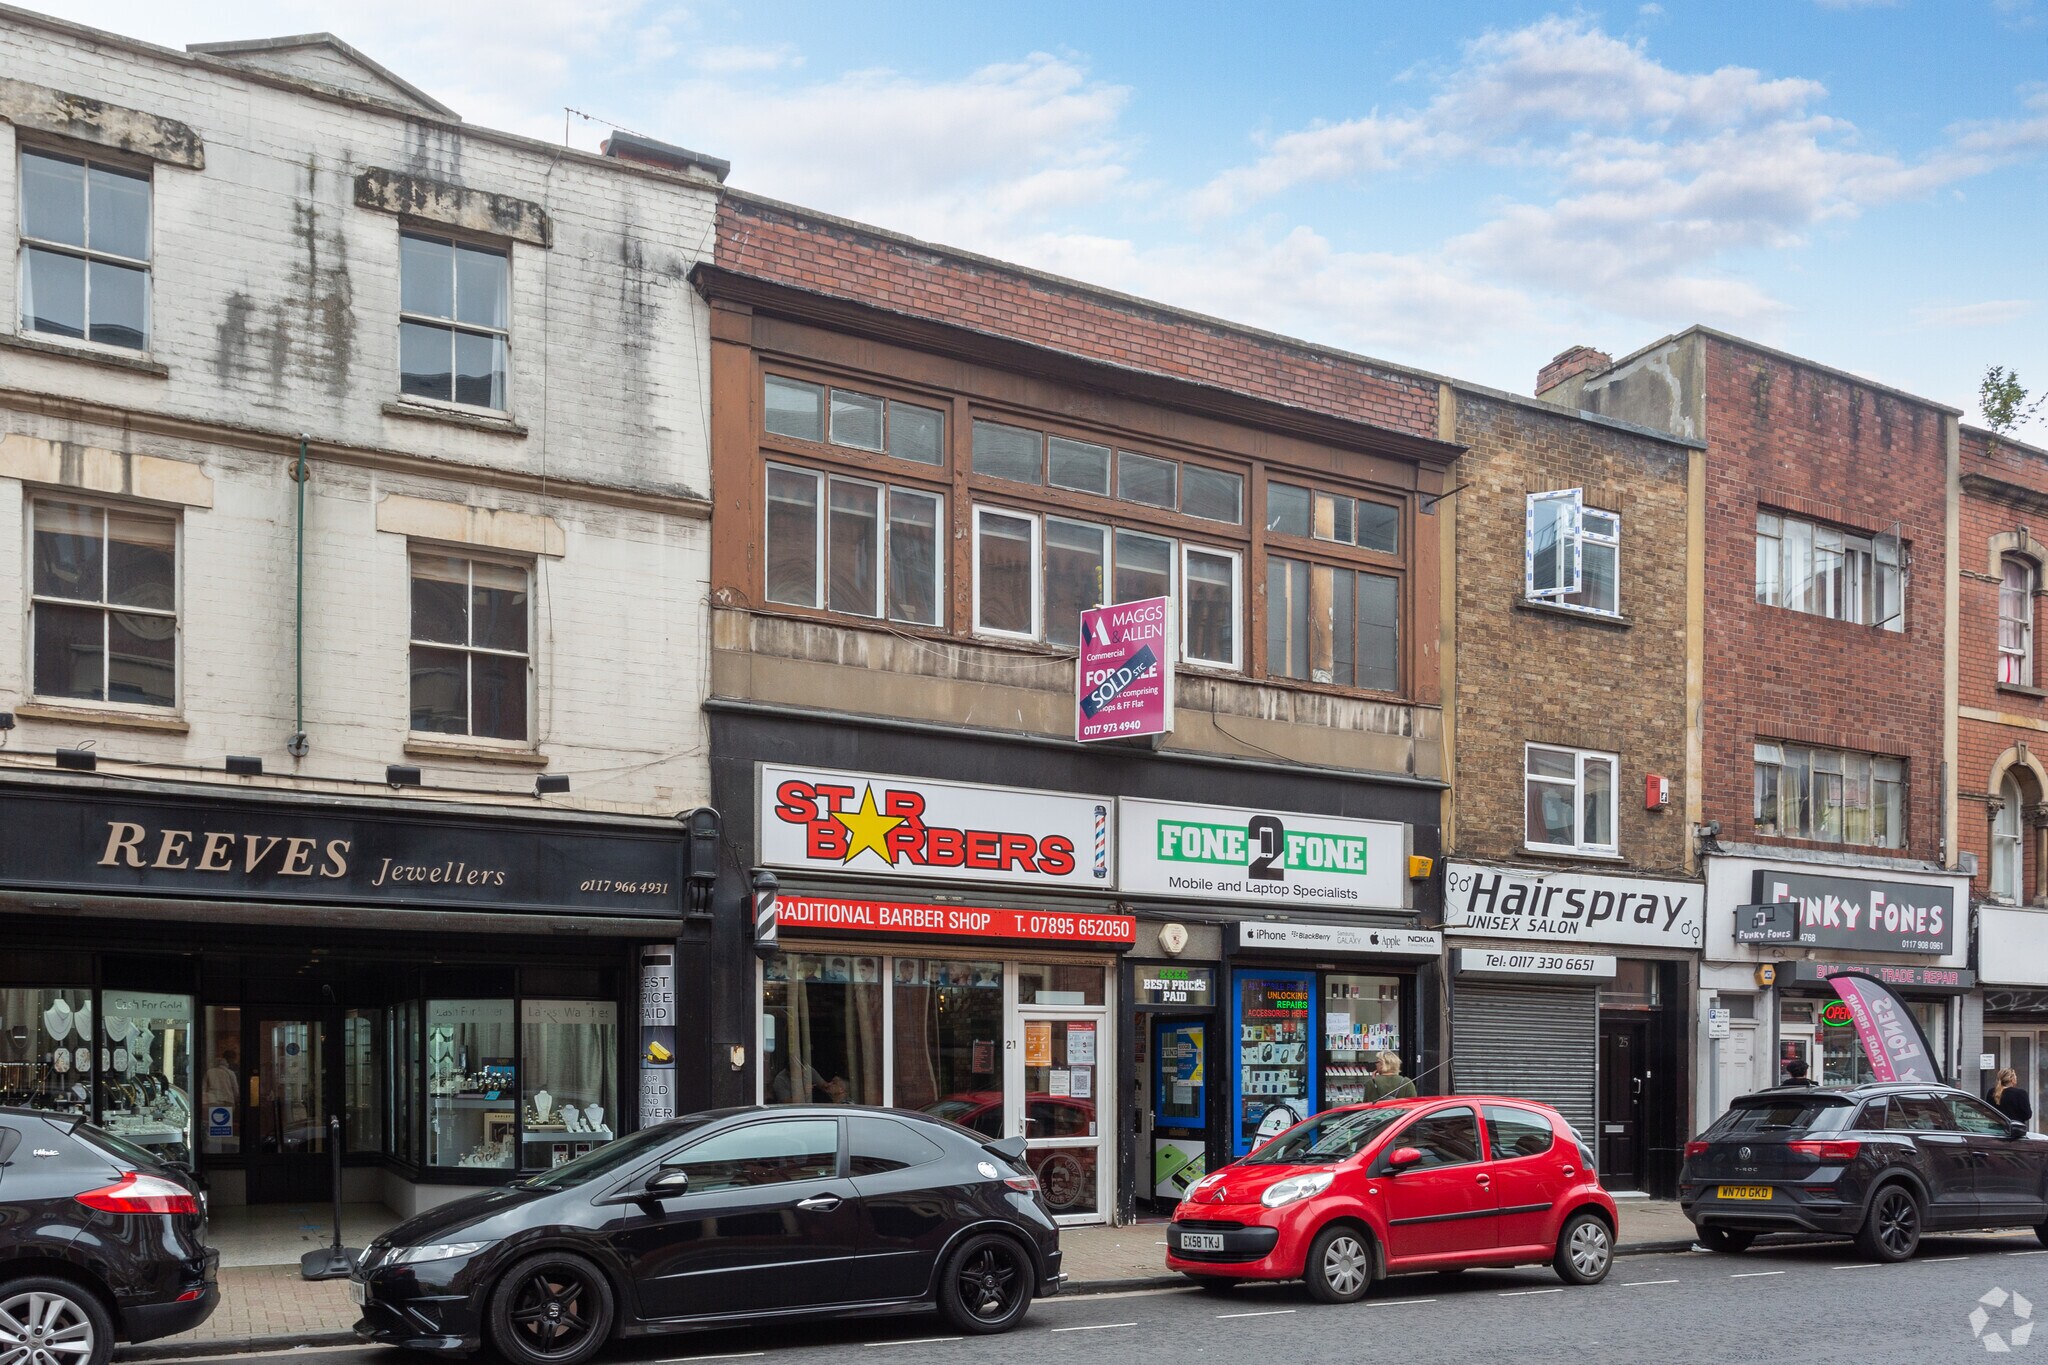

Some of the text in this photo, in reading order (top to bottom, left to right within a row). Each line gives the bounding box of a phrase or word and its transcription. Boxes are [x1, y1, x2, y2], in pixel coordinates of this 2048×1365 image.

[1112, 605, 1163, 627] MAGGS
[1111, 623, 1163, 643] & ALLEN
[1086, 647, 1125, 662] Commercial
[1091, 662, 1147, 709] SOLD STC
[1122, 686, 1159, 698] comprising
[1116, 702, 1123, 710] &
[1123, 701, 1131, 709] FF
[1131, 700, 1144, 708] Flat
[1084, 720, 1141, 735] 0117 973 4940
[775, 780, 926, 830] STR
[97, 820, 351, 879] REEVES
[806, 820, 1076, 876] BRBERS
[1161, 815, 1364, 881] FONE 2 FONE
[372, 856, 506, 887] Jewellers
[580, 879, 669, 896] 0117 966 4931
[1169, 876, 1358, 900] Mobile and Laptop Specialists
[1467, 873, 1688, 932] Hairspray
[774, 901, 991, 931] RADITIONAL BARBER SHOP
[1869, 890, 1943, 935] FONES
[1015, 914, 1130, 937] T. 07895 652050
[1466, 914, 1579, 935] UNISEX SALON
[1256, 928, 1287, 941] iPhone
[1298, 932, 1331, 942] BlackBerry
[1337, 936, 1362, 945] GALAXY
[1408, 936, 1435, 944] NOKIA
[1739, 929, 1791, 939] FUNKY FONES
[1381, 935, 1400, 948] Apple
[1902, 940, 1944, 950] 0117 908 0961
[1486, 954, 1594, 971] Tel: 0117 330 6651
[1881, 968, 1915, 983] TRADE
[1923, 970, 1958, 985] REPAIR
[1143, 979, 1206, 991] BEST PRICES
[1163, 991, 1187, 1002] PAID
[1267, 991, 1308, 1000] UNLOCKING
[115, 998, 182, 1010] Cash For Gold
[1276, 1000, 1308, 1009] REPAIRS
[564, 1007, 609, 1018] Wahes
[1247, 1009, 1308, 1018] ACCESSORIES HERE
[1826, 1006, 1851, 1020] OPEN
[1006, 1040, 1017, 1049] 21
[1618, 1036, 1629, 1048] 25
[1722, 1186, 1768, 1198] WN70 GKD
[1203, 1236, 1220, 1248] TKJ
